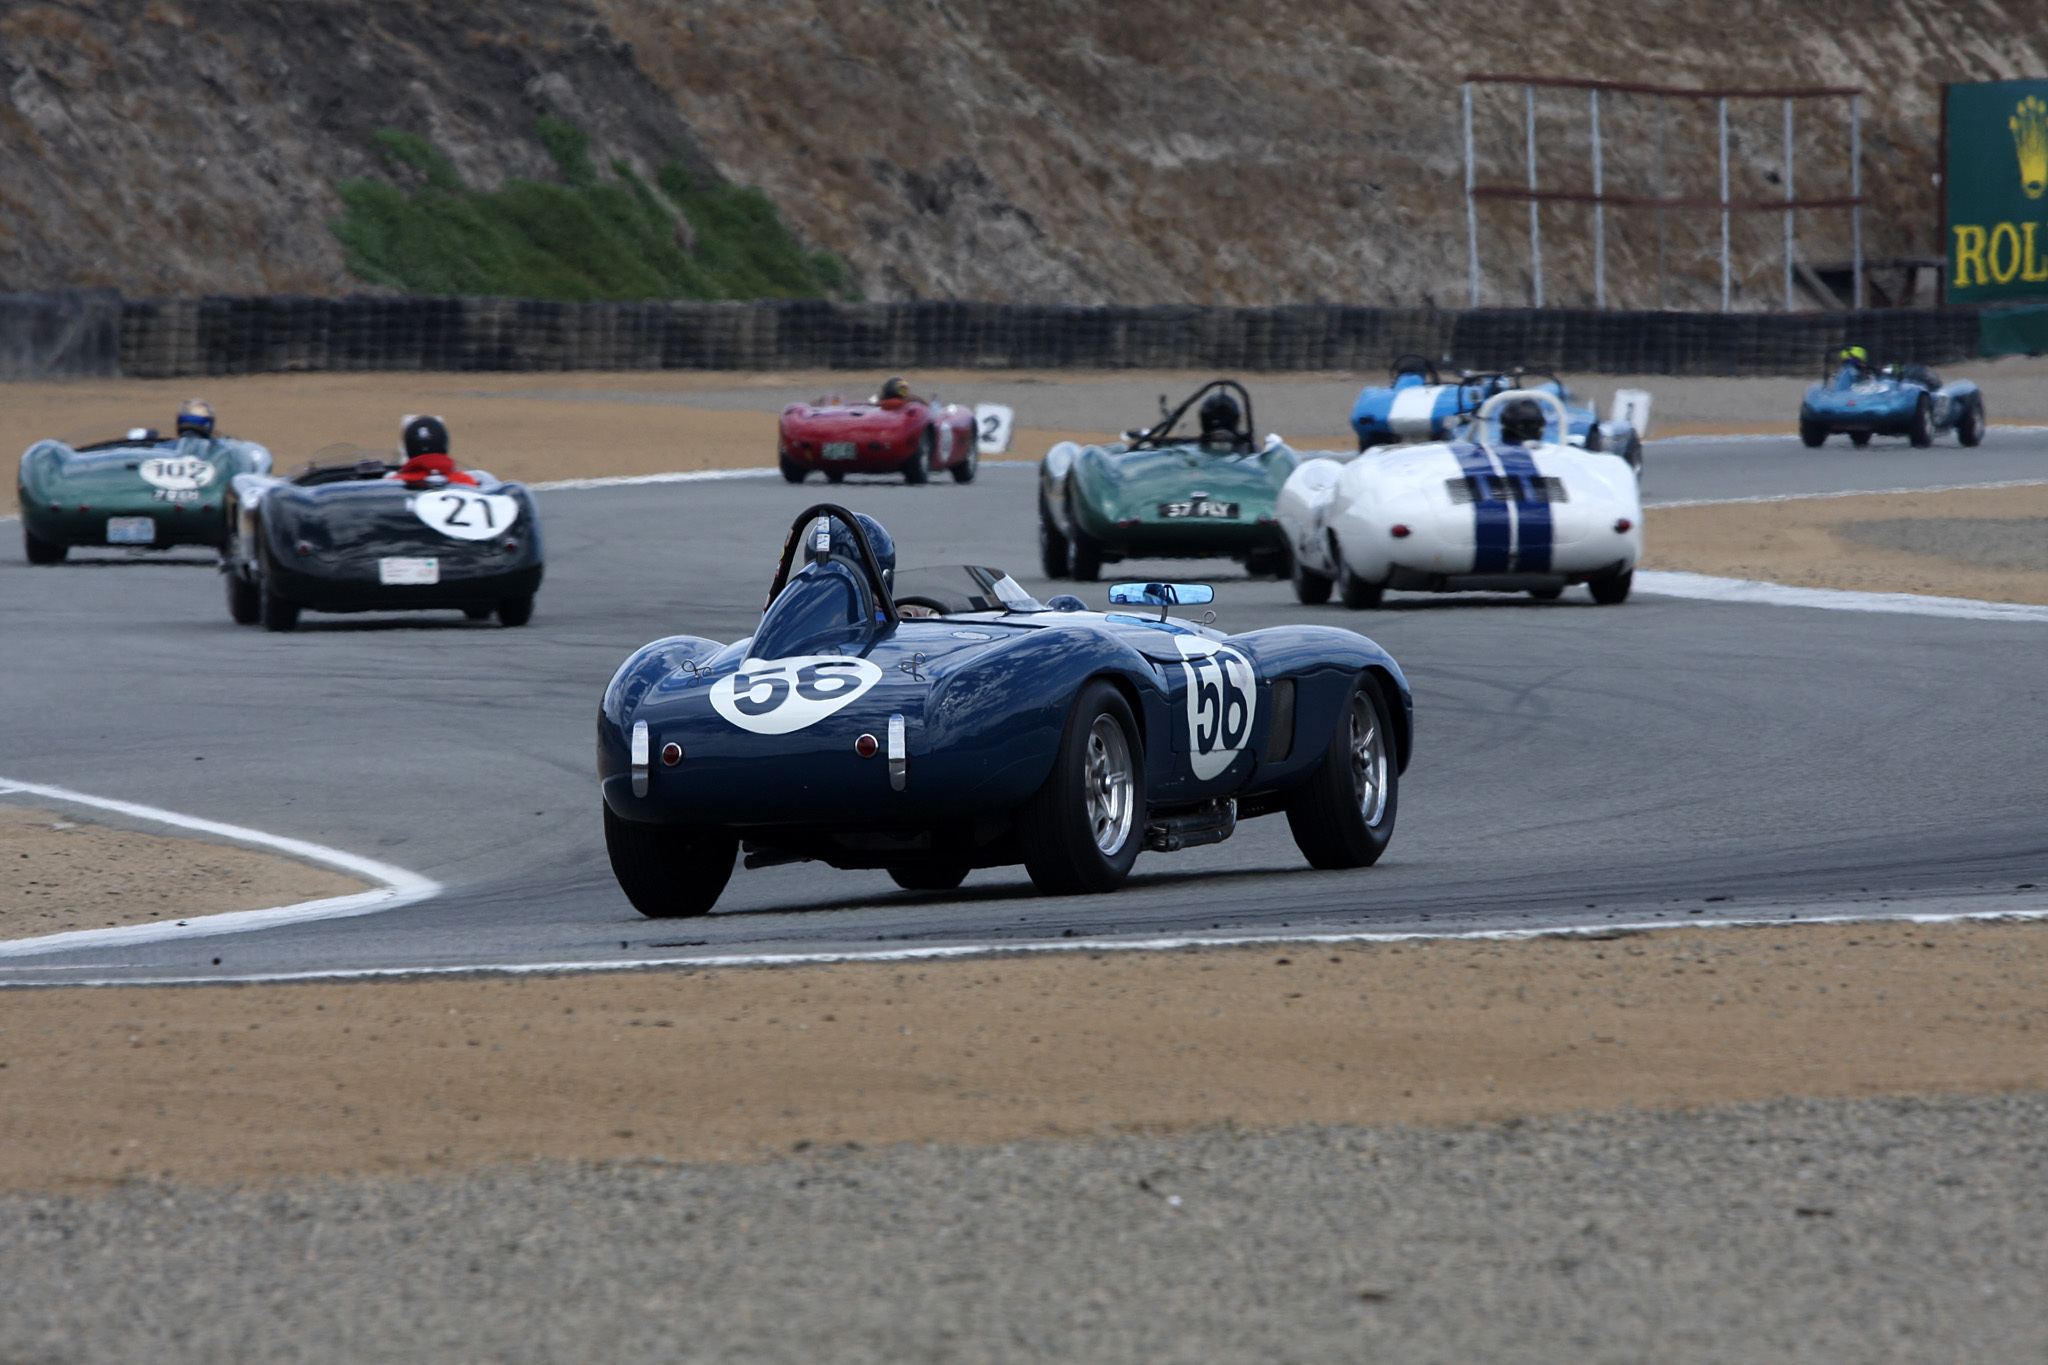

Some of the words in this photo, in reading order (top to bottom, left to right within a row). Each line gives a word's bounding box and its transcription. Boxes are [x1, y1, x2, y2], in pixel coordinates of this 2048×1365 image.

[981, 414, 1001, 443] 2
[152, 461, 208, 479] 102
[440, 496, 495, 528] 21
[733, 662, 863, 716] 56
[1184, 650, 1248, 756] 56
